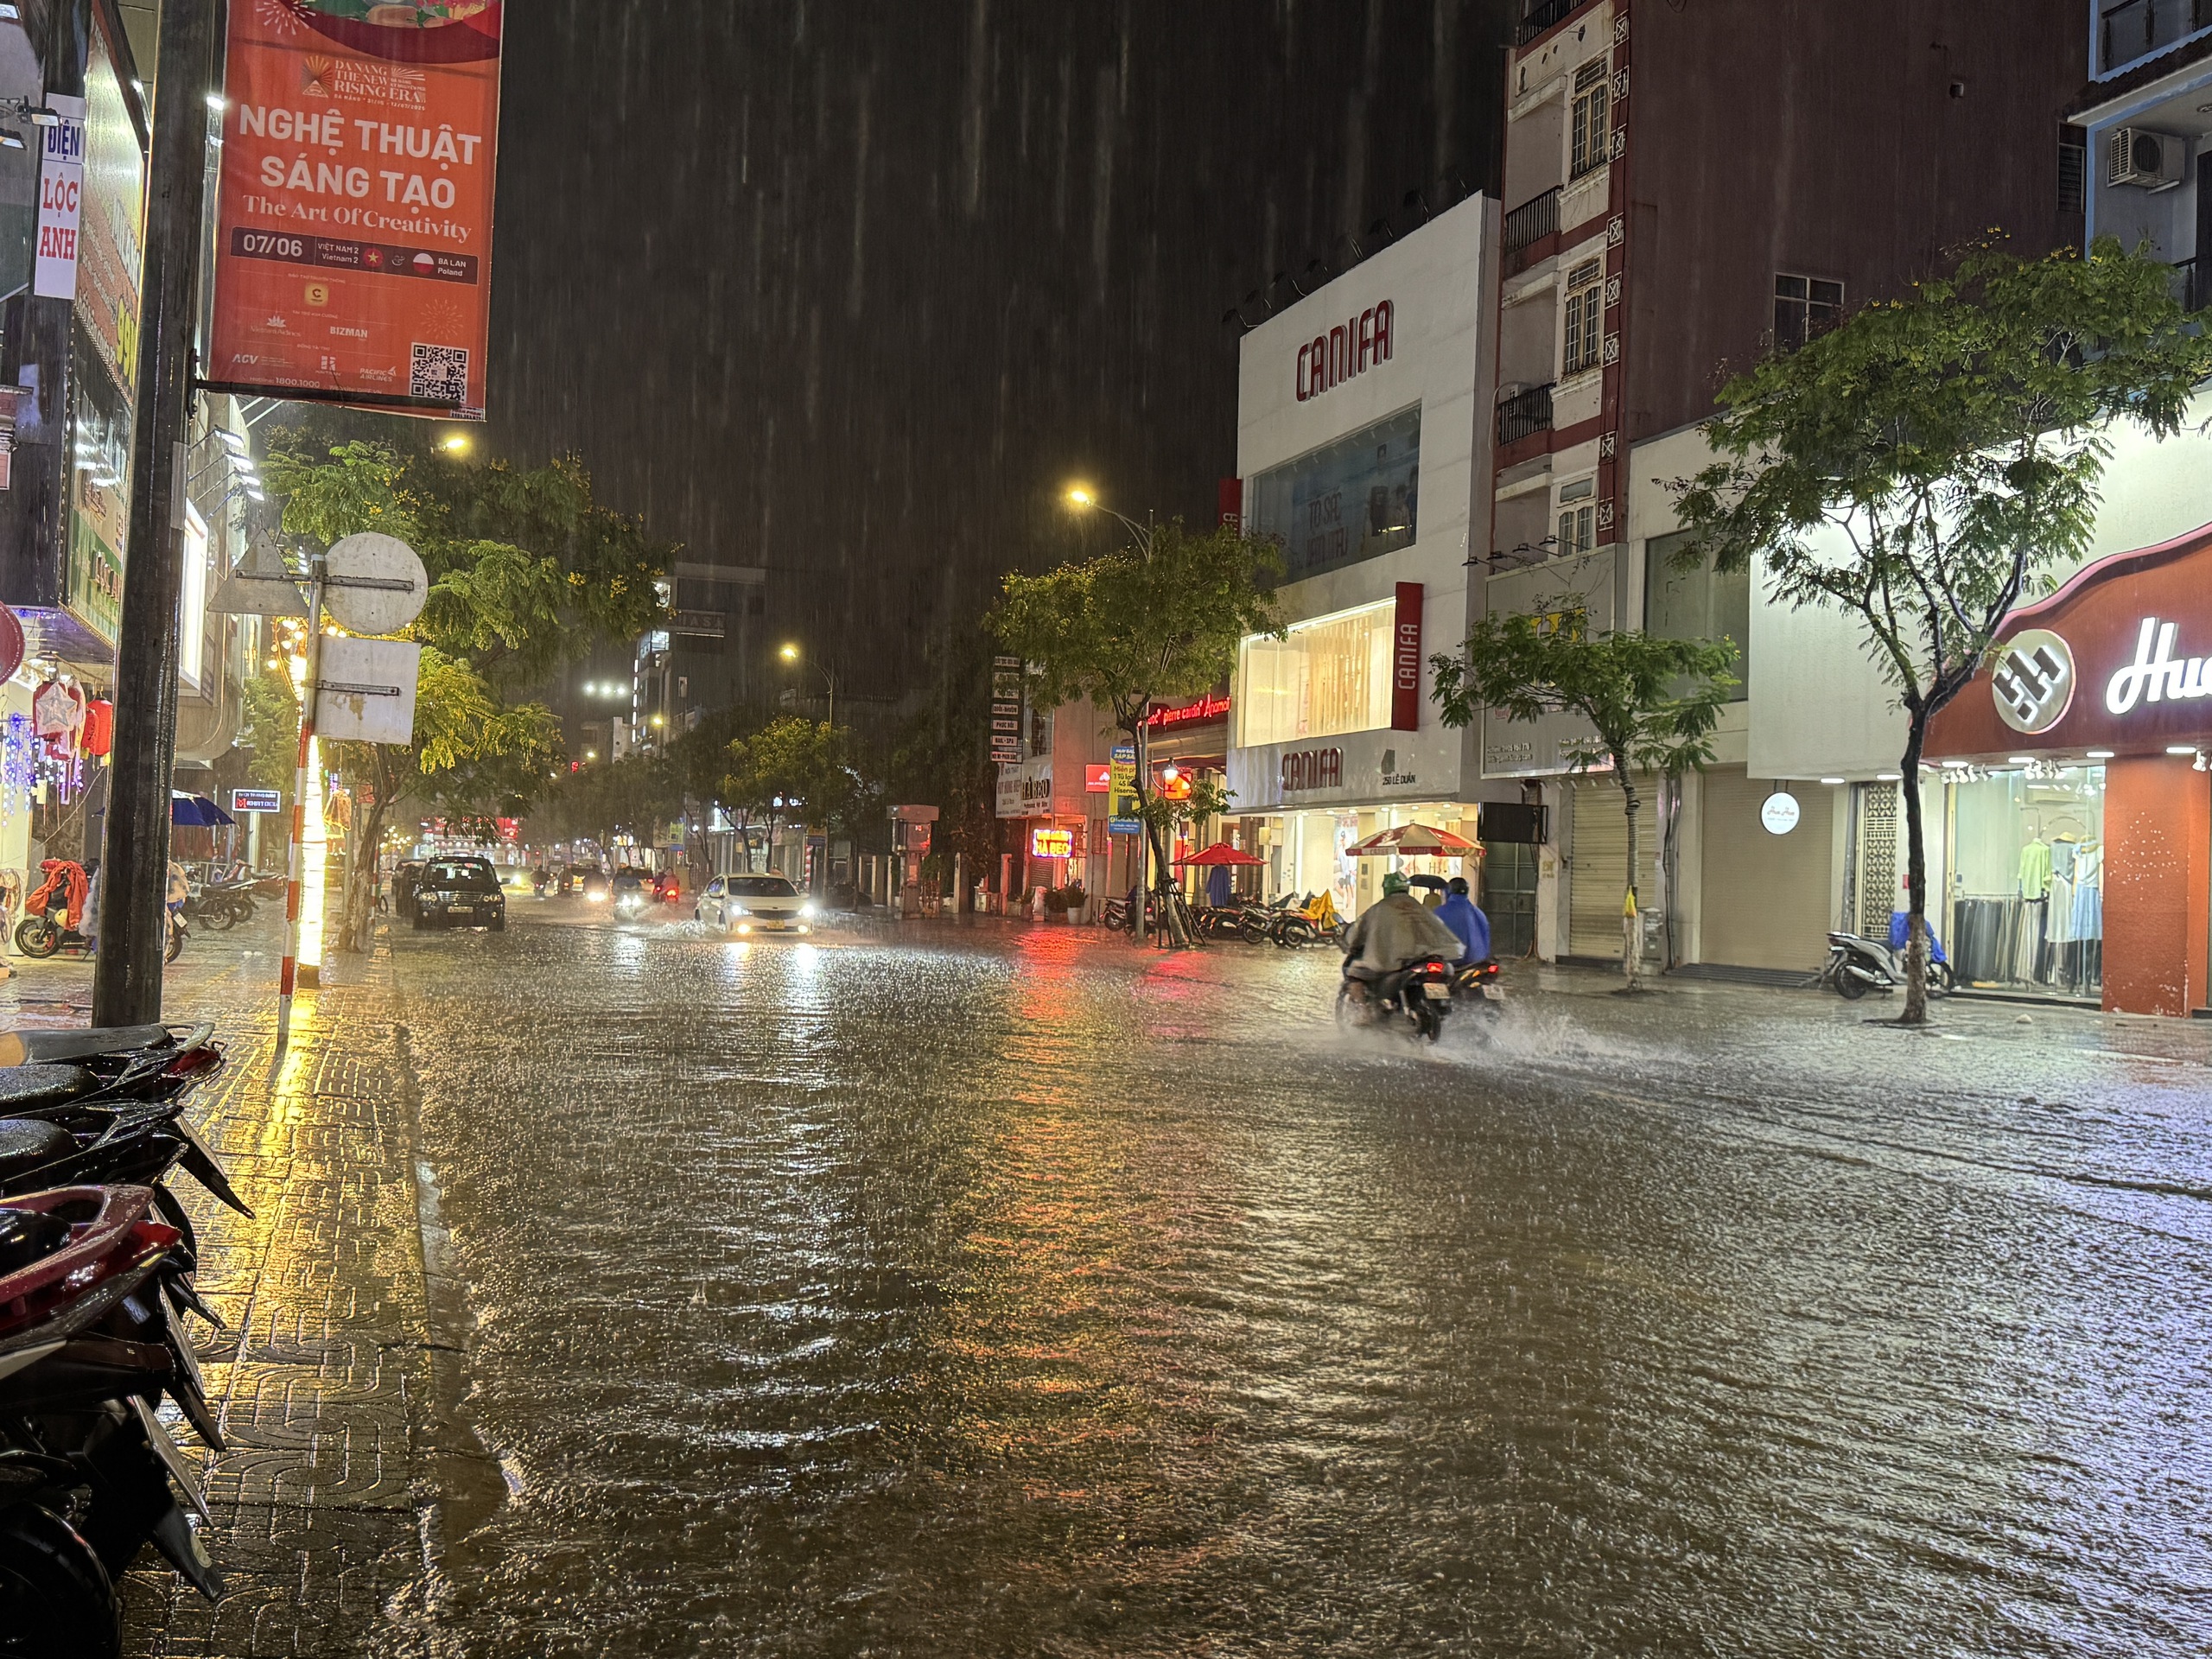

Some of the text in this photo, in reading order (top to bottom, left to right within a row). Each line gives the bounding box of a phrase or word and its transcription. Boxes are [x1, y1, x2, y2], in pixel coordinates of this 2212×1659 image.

[334, 70, 361, 82] THE
[363, 74, 387, 85] NEW
[355, 63, 387, 75] NANG
[334, 80, 386, 98] RISING
[389, 88, 422, 102] ERA
[47, 119, 81, 161] ĐIỆN
[239, 104, 482, 171] NGHỆ THUẬT
[260, 152, 455, 214] SÁNG TẠO
[43, 172, 79, 219] LỘC
[243, 194, 473, 244] The Art Of Creativity
[39, 226, 77, 261] ANH
[243, 233, 303, 257] 07/06
[317, 243, 335, 253] VIỆT
[335, 245, 353, 254] NAM
[321, 253, 353, 264] Vietnam
[438, 257, 467, 269] BA LAN
[437, 267, 463, 277] Poland
[329, 326, 368, 339] BIZMAN
[1296, 299, 1395, 403] CANIFA
[359, 367, 387, 377] PACIFIC
[359, 374, 393, 383] AIRLINES
[275, 376, 321, 389] 1800.1000
[1397, 623, 1418, 690] CANIFA
[1163, 709, 1180, 726] pierre
[1281, 747, 1344, 791] CANIFA
[1392, 774, 1400, 785] LÊ
[1400, 772, 1416, 785] DUẨN
